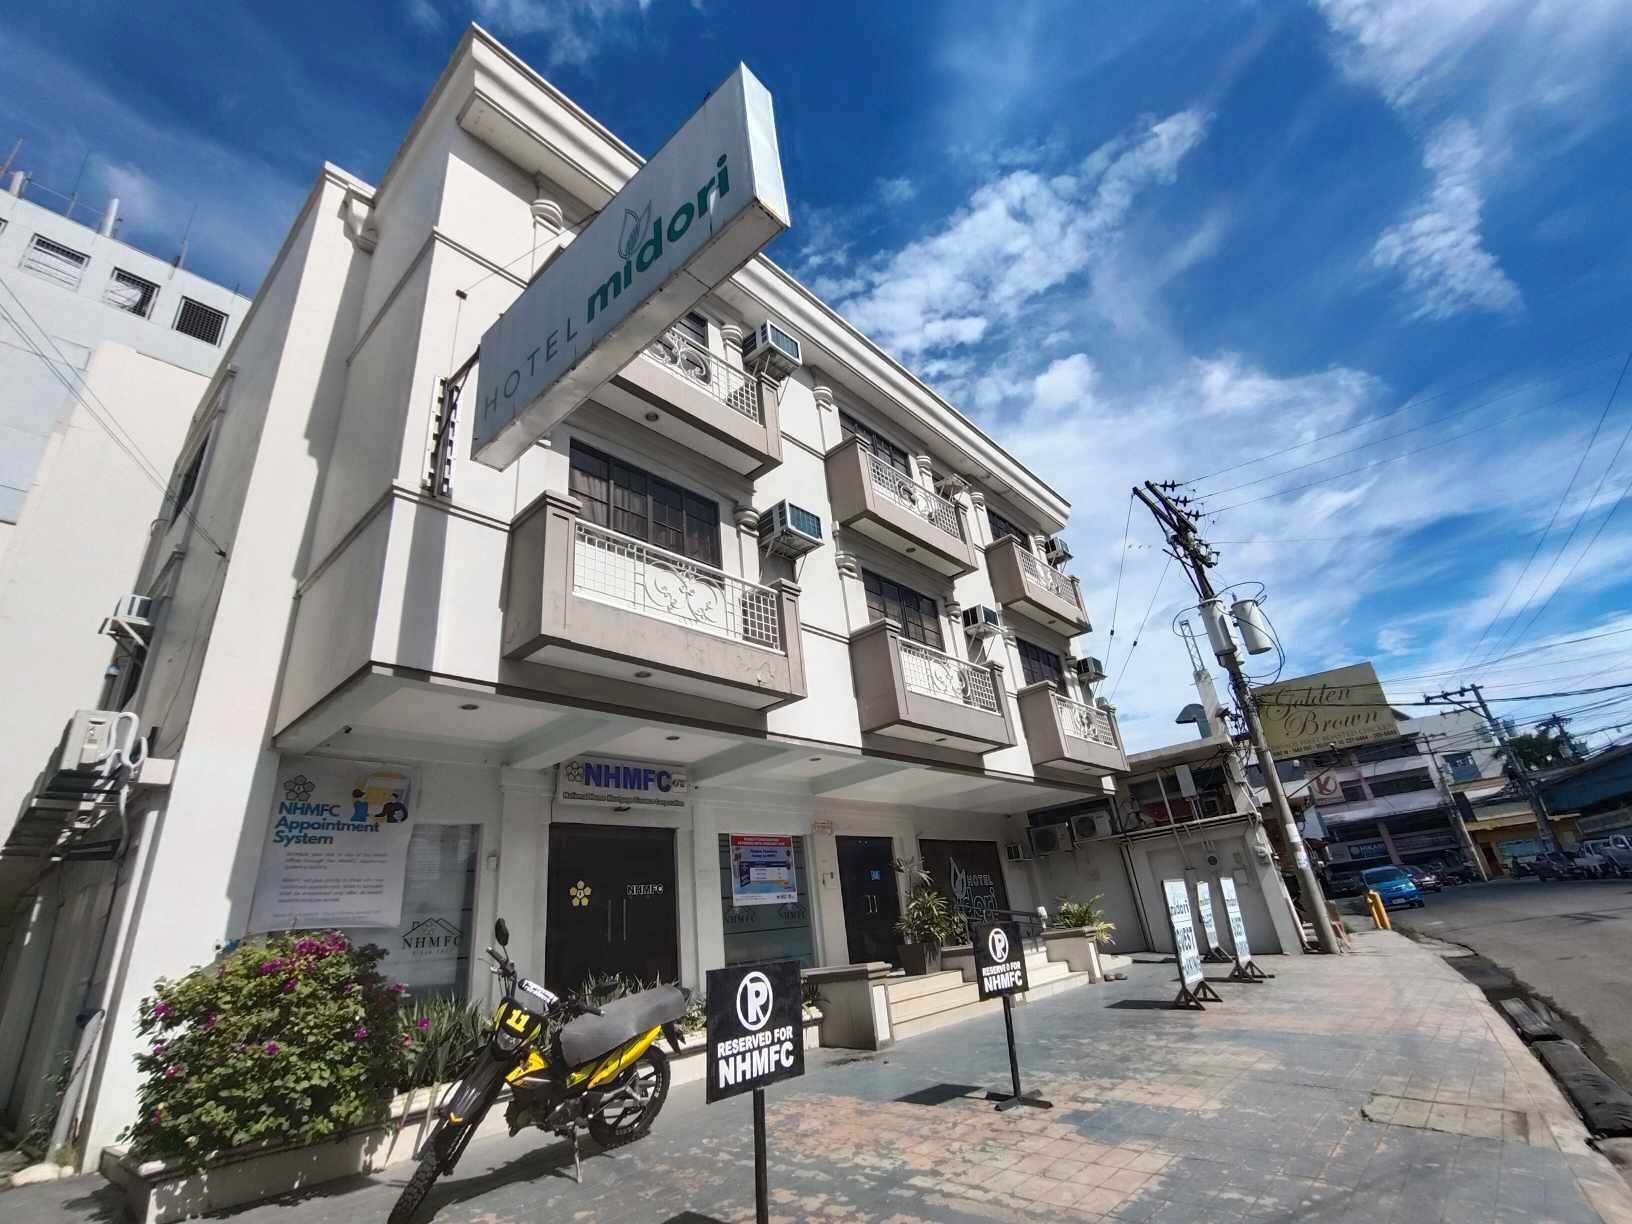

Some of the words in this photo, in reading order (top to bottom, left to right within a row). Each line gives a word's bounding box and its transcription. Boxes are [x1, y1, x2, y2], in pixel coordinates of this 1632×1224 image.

[483, 316, 578, 420] HOTEL
[586, 153, 730, 324] midori
[1267, 684, 1350, 719] Golden
[1283, 709, 1378, 736] Brown
[584, 762, 673, 793] NHMFC
[279, 801, 341, 817] NHMFC
[275, 816, 381, 833] Appointment
[273, 830, 335, 848] System
[626, 884, 664, 895] NHMFC
[402, 935, 463, 950] NHMFC
[982, 963, 1010, 977] RESERVED
[1010, 961, 1021, 970] FOR
[983, 970, 1023, 993] NHMFC
[717, 1031, 772, 1058] RESERVED
[774, 1025, 793, 1041] FOR
[718, 1041, 795, 1089] NHMFC
